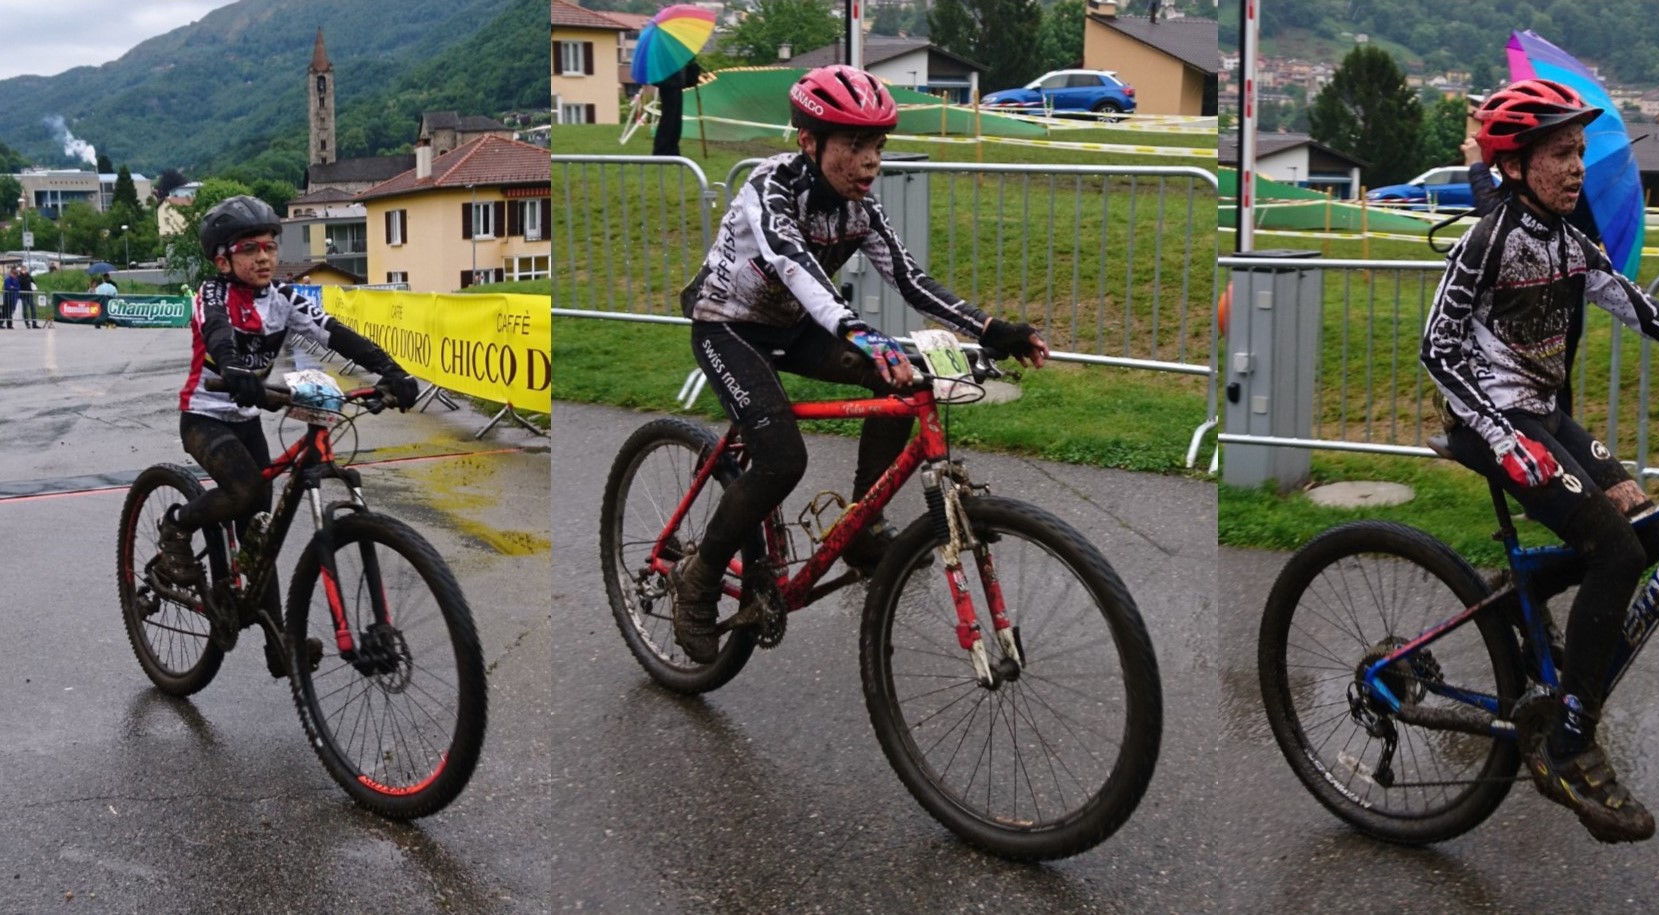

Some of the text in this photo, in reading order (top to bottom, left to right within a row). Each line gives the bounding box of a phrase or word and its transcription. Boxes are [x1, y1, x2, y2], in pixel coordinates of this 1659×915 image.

[107, 298, 184, 319] Champion
[496, 310, 531, 335] CAFFÈ
[363, 321, 399, 358] CHICCO
[400, 329, 431, 368] D'ORO
[440, 336, 517, 387] CHICCO
[946, 348, 962, 374] 8
[701, 338, 751, 409] swiss made
